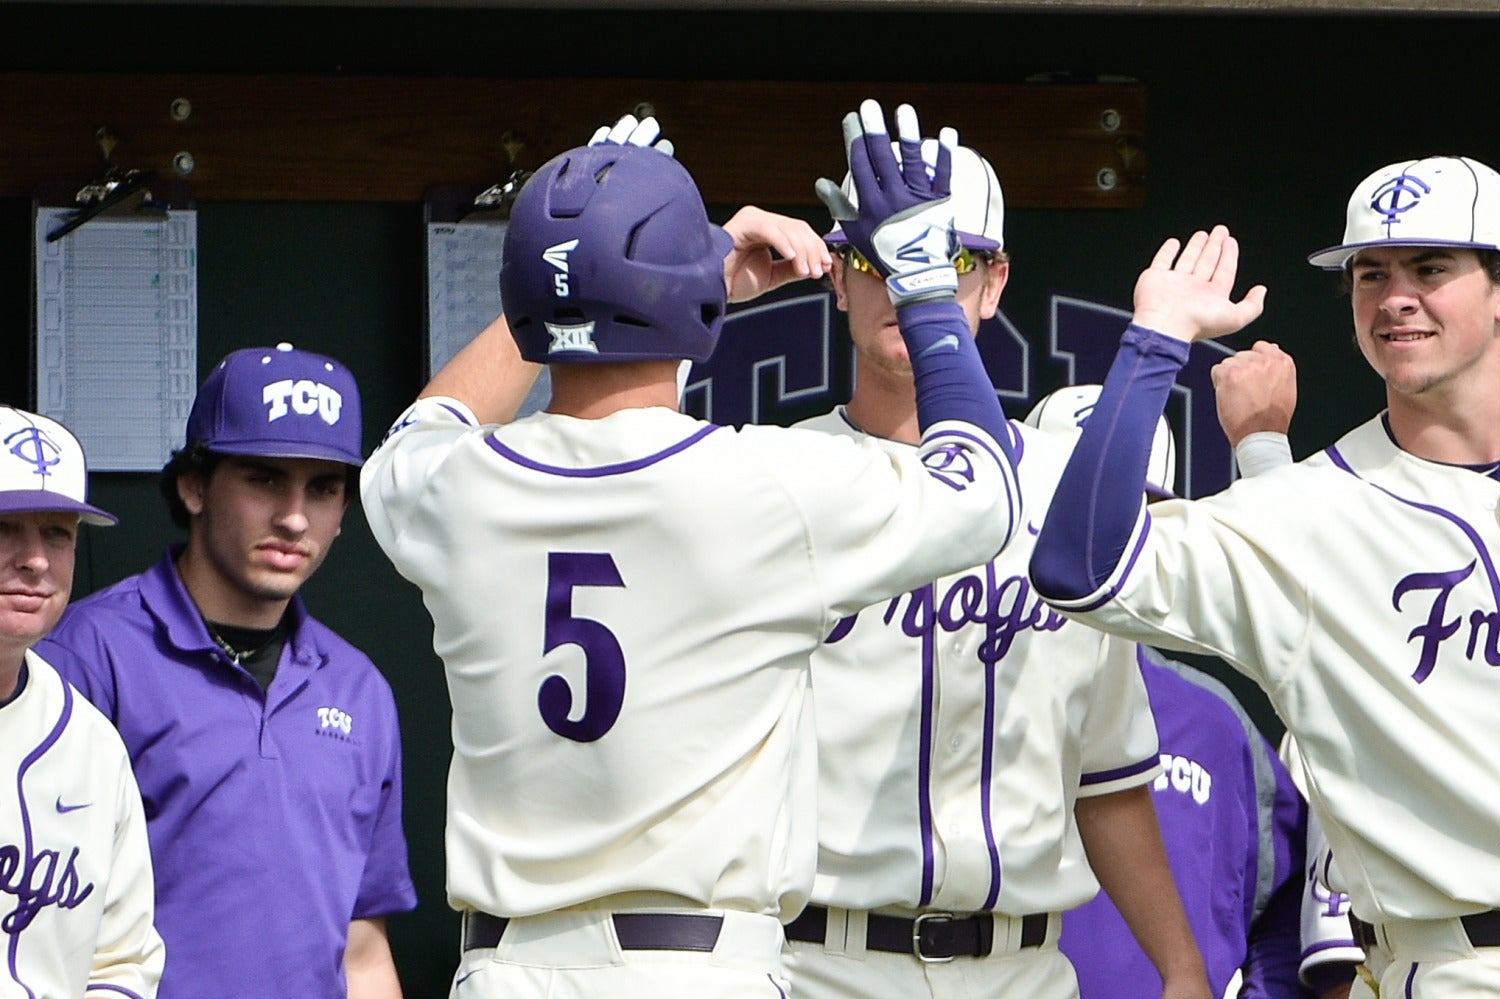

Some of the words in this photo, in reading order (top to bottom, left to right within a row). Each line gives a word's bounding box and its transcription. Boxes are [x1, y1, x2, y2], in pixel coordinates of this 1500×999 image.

[554, 272, 570, 297] 5
[262, 379, 343, 426] TCU
[823, 575, 1068, 663] rog
[537, 552, 626, 743] 5
[317, 706, 353, 735] TCU
